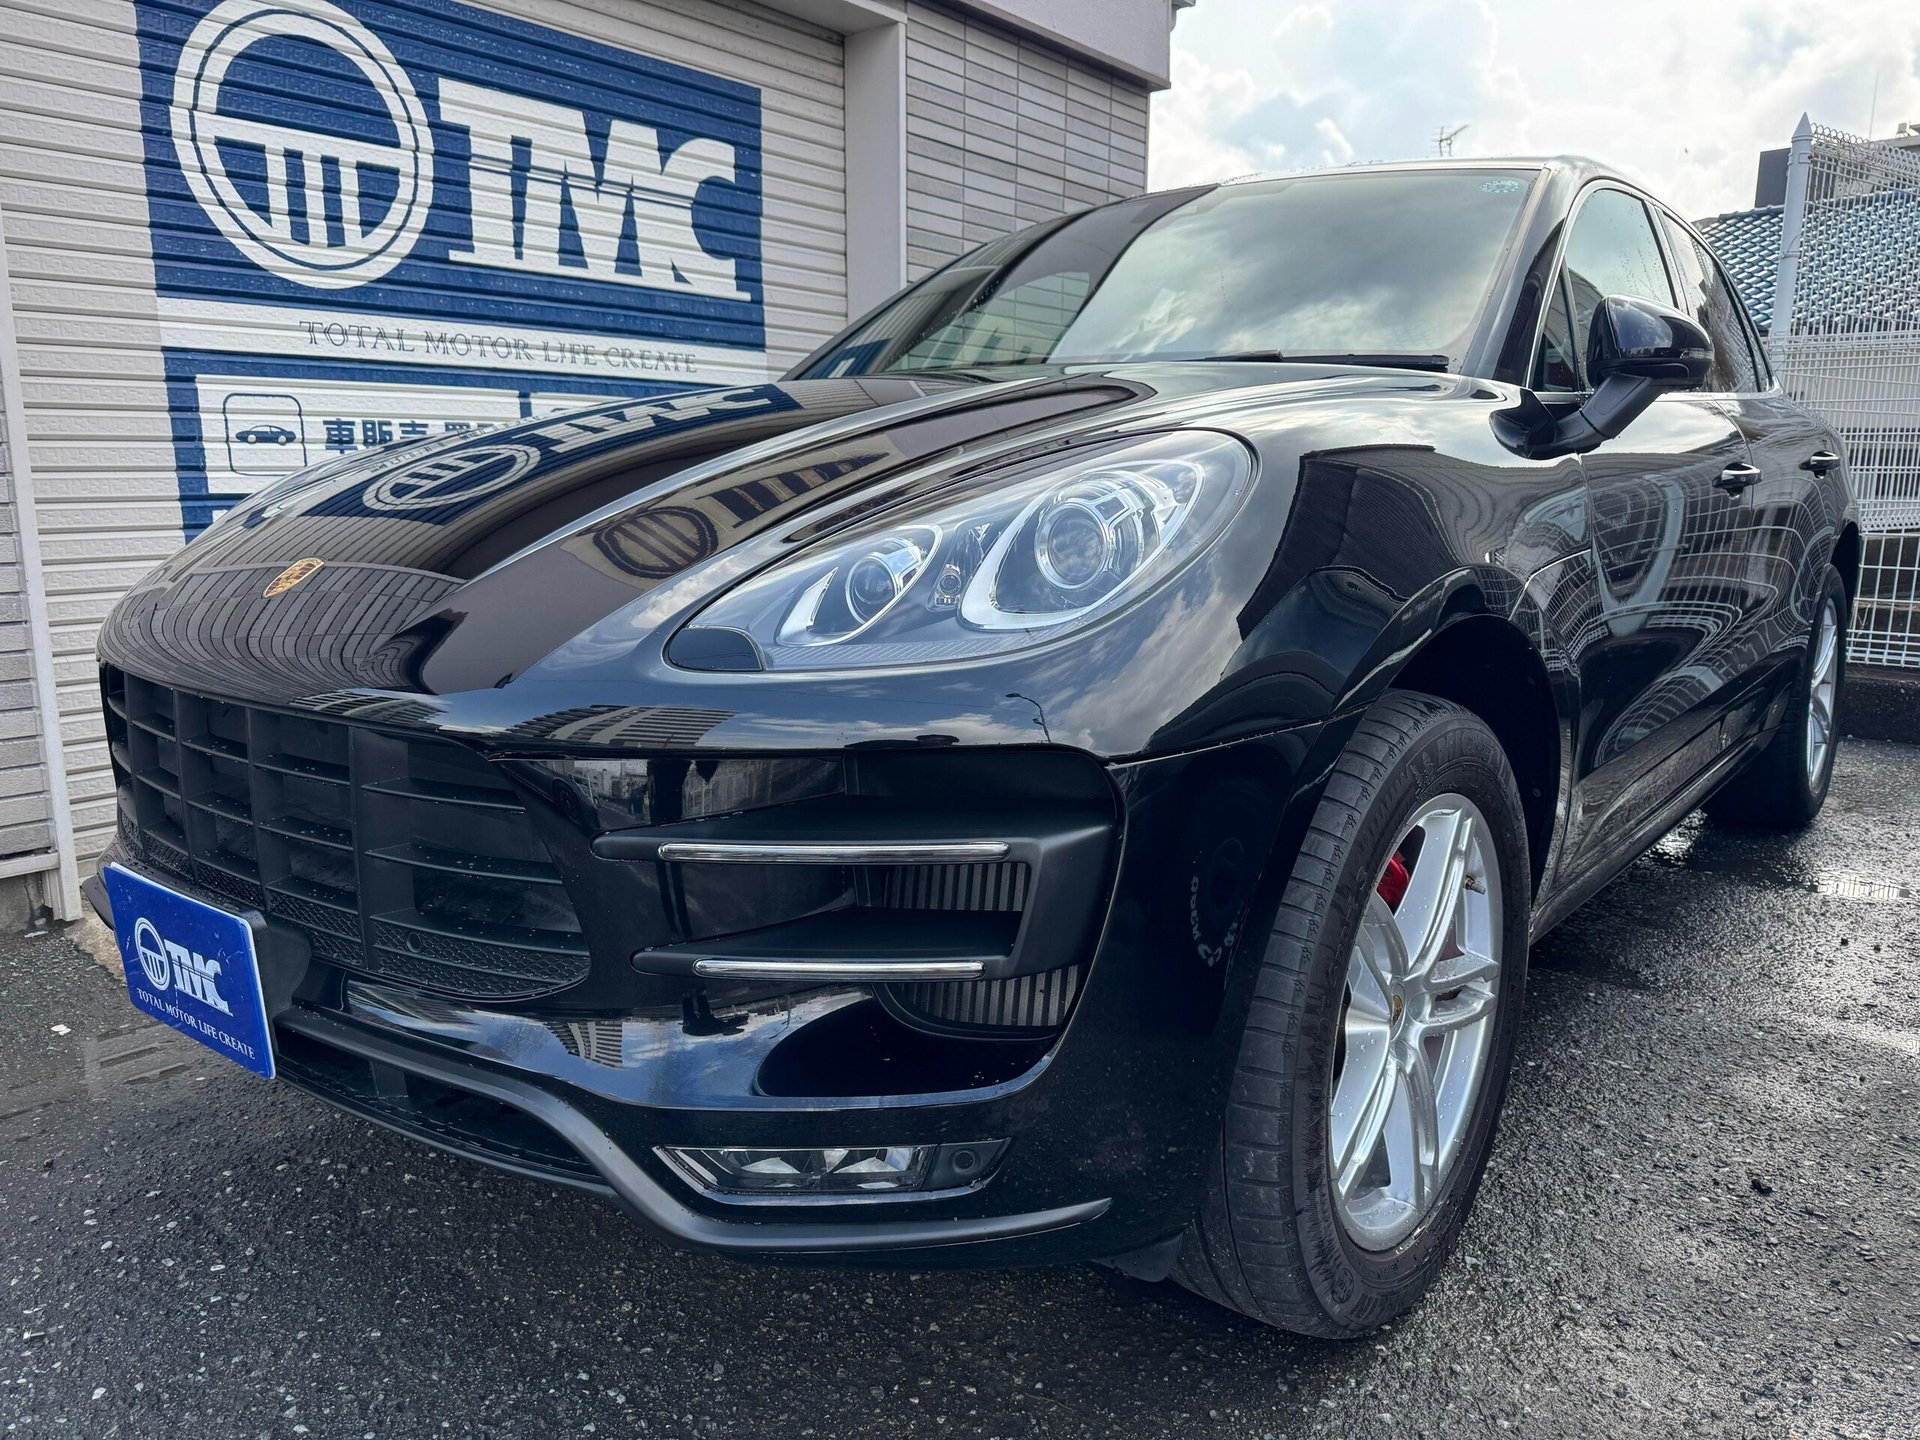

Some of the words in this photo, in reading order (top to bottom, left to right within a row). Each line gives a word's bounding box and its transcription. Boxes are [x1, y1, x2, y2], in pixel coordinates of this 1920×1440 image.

[438, 77, 751, 302] TMC
[300, 321, 414, 353] TOTAL
[424, 330, 535, 361] MOTOR
[542, 341, 597, 366] LIFE
[604, 347, 698, 373] CREATE
[164, 939, 234, 1017] TMC
[137, 987, 165, 1012] TOTAL
[165, 1001, 198, 1029] MOTOR
[198, 1020, 218, 1039] LIFE
[218, 1031, 256, 1060] CREATE
